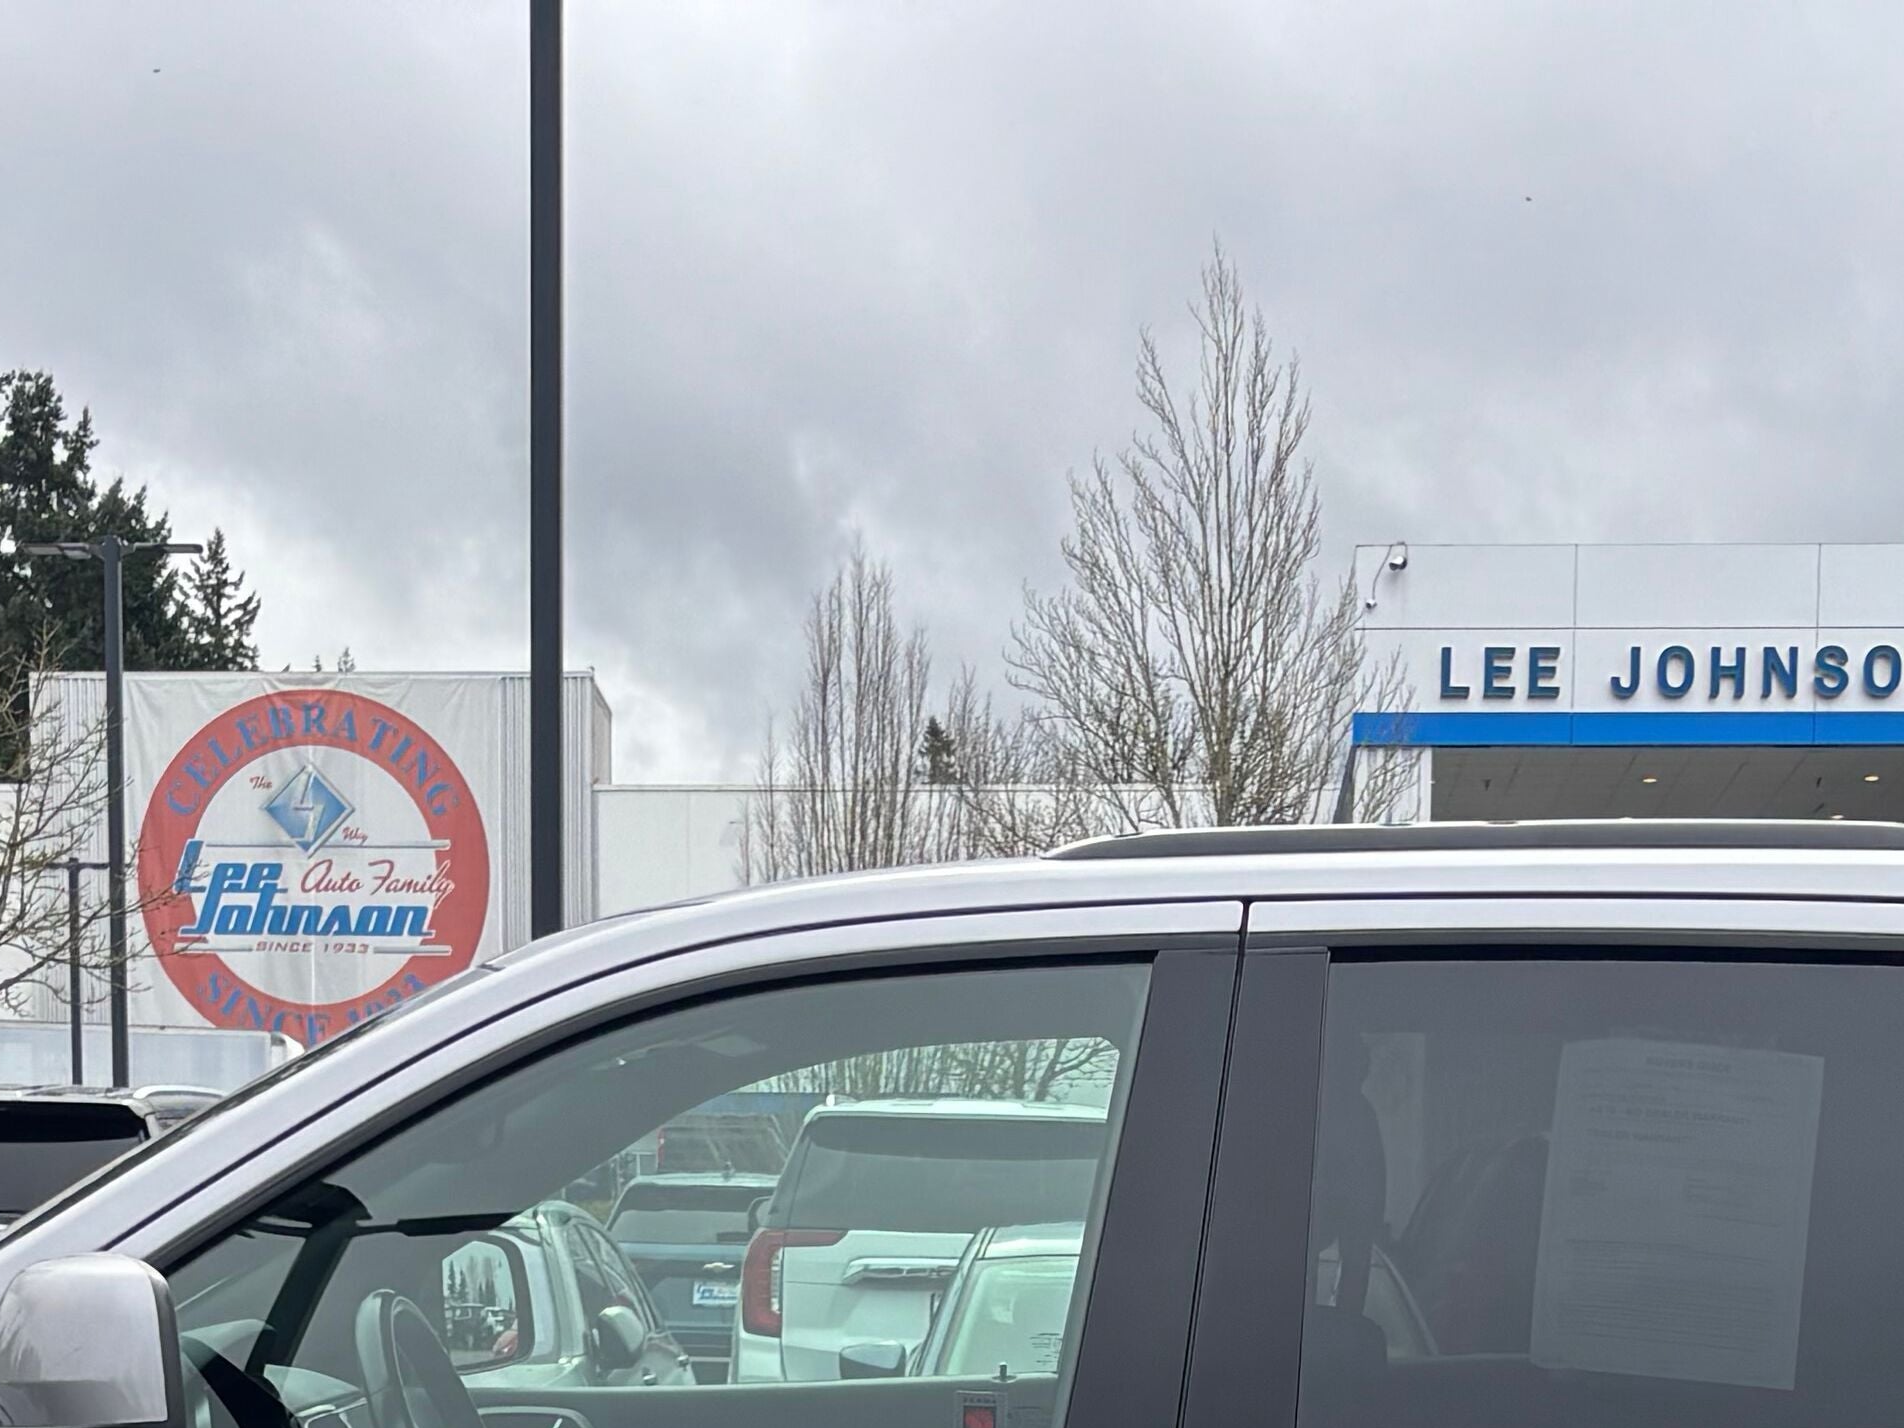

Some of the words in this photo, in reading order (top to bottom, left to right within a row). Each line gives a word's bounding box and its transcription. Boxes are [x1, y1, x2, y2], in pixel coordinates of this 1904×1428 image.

[1439, 645, 1562, 701] LEE
[165, 700, 461, 817] CELEBRATING
[250, 776, 273, 791] The
[173, 840, 288, 894] Lee
[300, 858, 365, 895] Auto
[367, 858, 456, 910] Family
[179, 888, 434, 937] Johnson
[255, 940, 313, 954] SINCE
[322, 940, 370, 955] 1933
